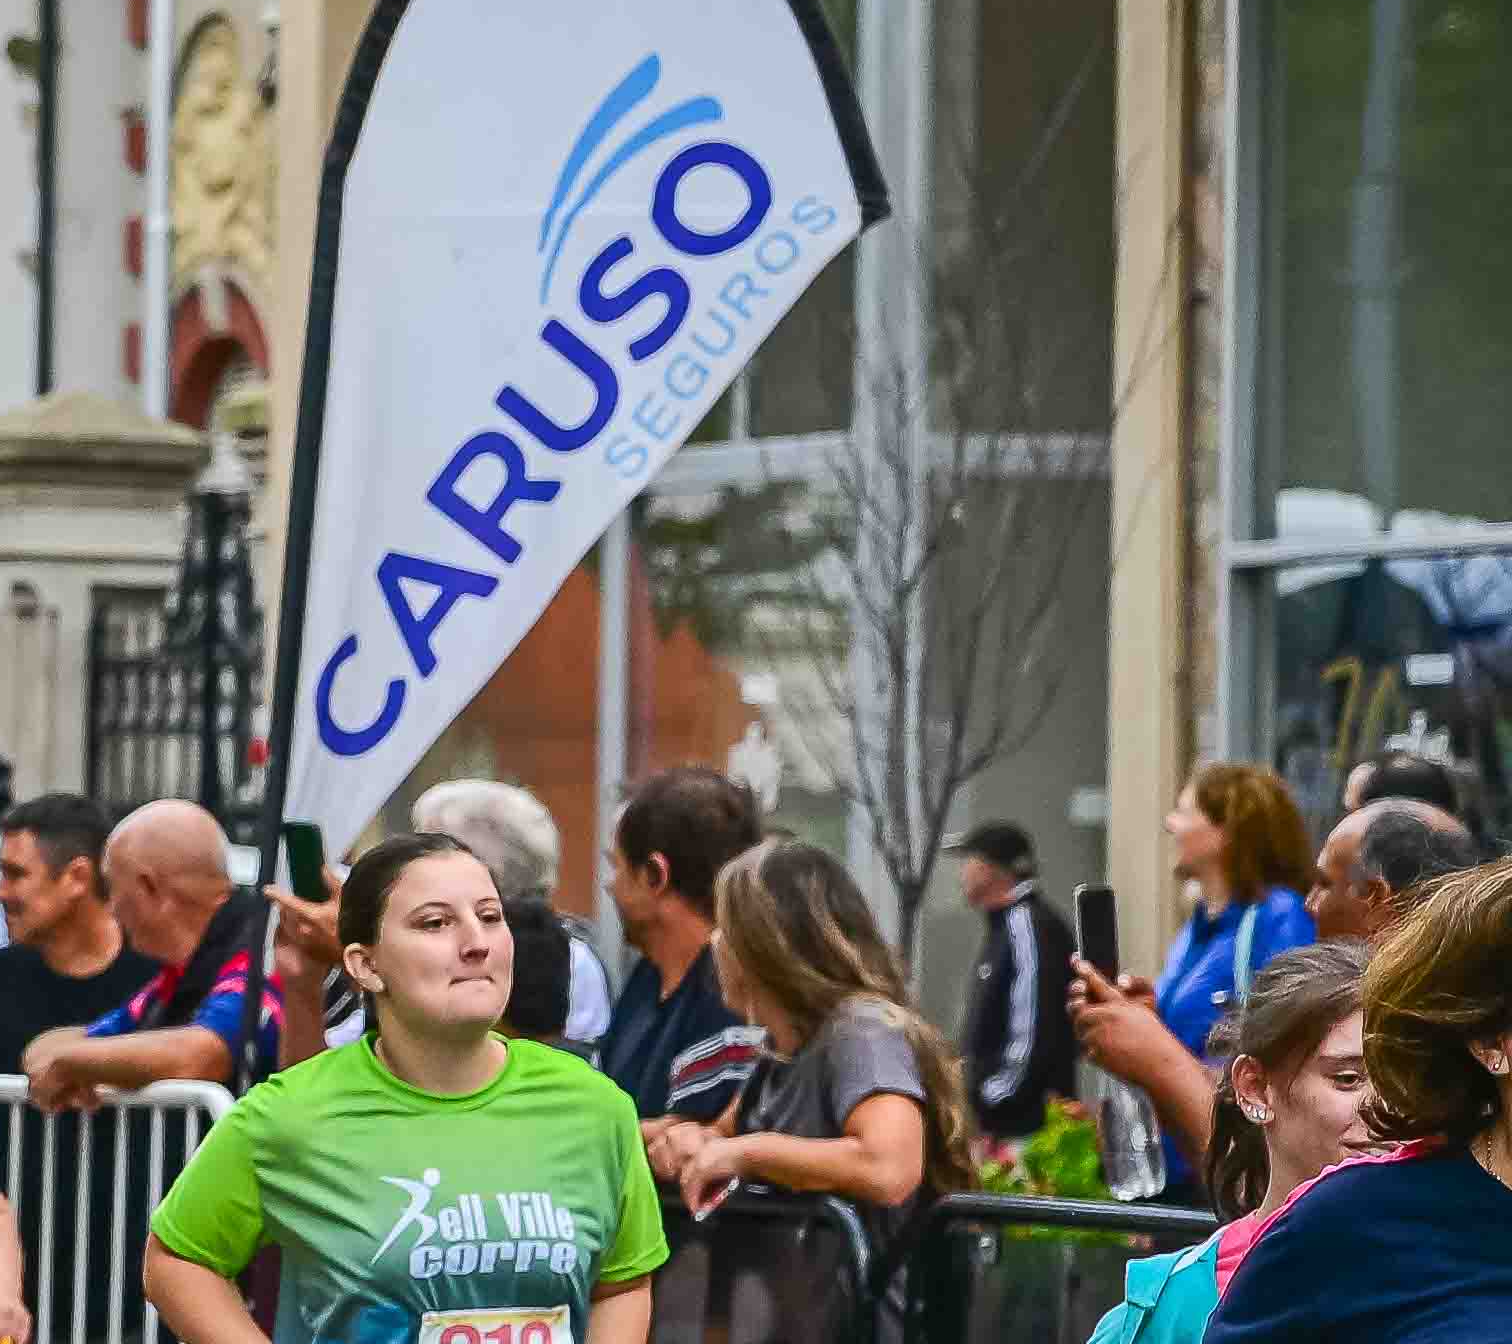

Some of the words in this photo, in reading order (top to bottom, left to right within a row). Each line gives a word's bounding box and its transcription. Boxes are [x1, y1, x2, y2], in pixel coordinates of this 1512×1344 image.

[605, 193, 840, 480] SEGUROS
[315, 141, 773, 758] CARUSO
[410, 1240, 578, 1280] corre
[496, 1191, 576, 1241] Ville
